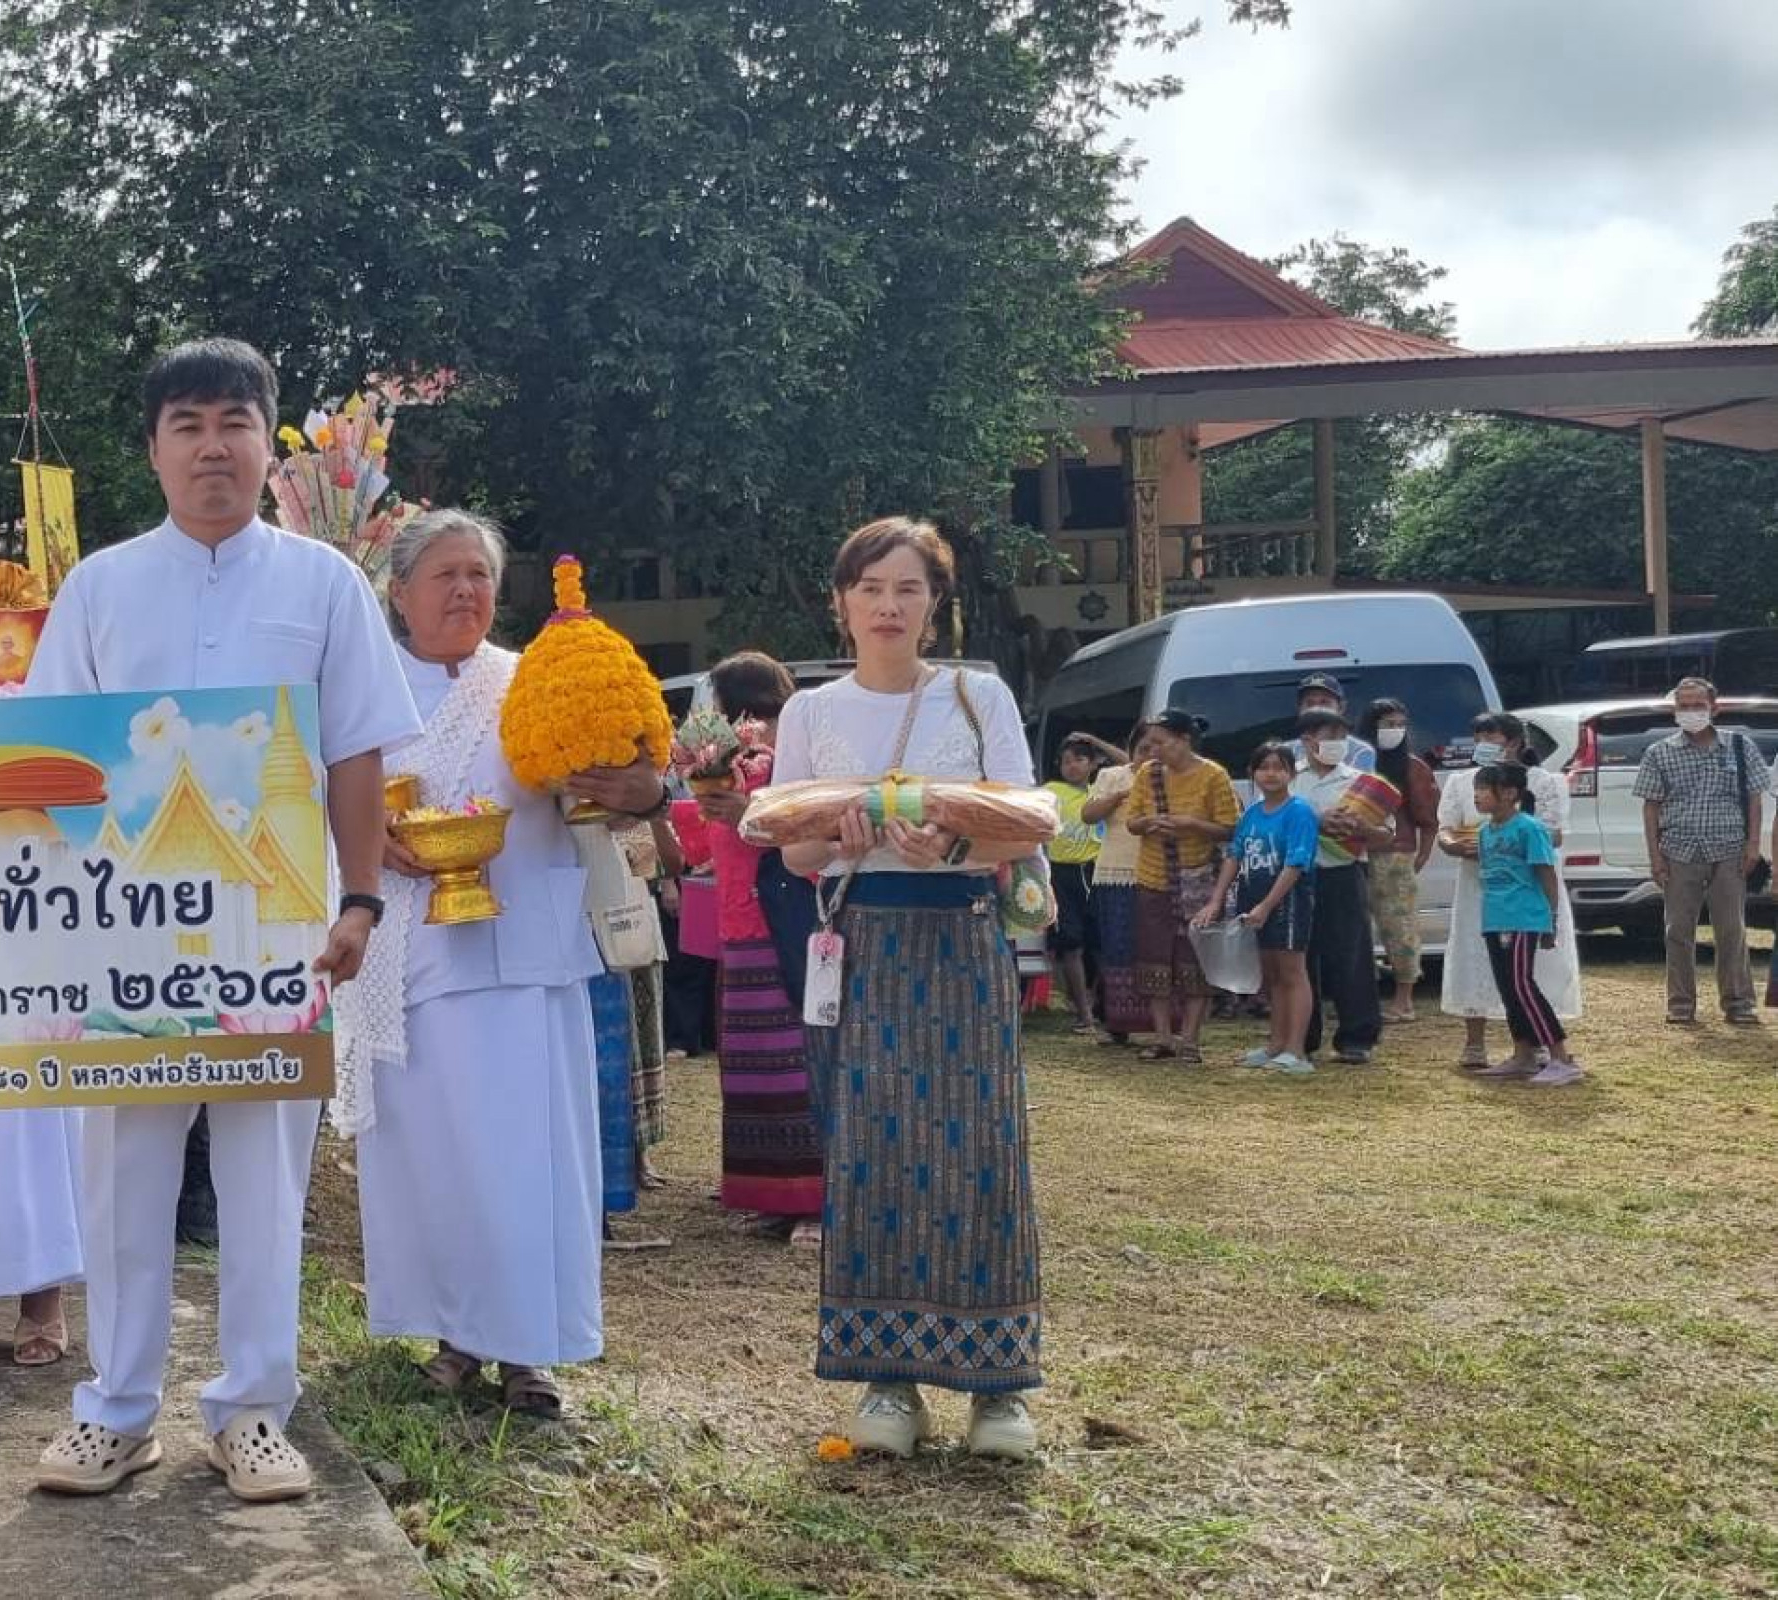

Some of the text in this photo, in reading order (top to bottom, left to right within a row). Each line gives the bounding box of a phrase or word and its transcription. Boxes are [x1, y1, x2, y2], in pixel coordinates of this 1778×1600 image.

[107, 960, 308, 1012] ๒๕๖๘
[38, 1058, 60, 1088] ปี
[71, 1050, 301, 1089] หลวงพ่อธัมมชโย
